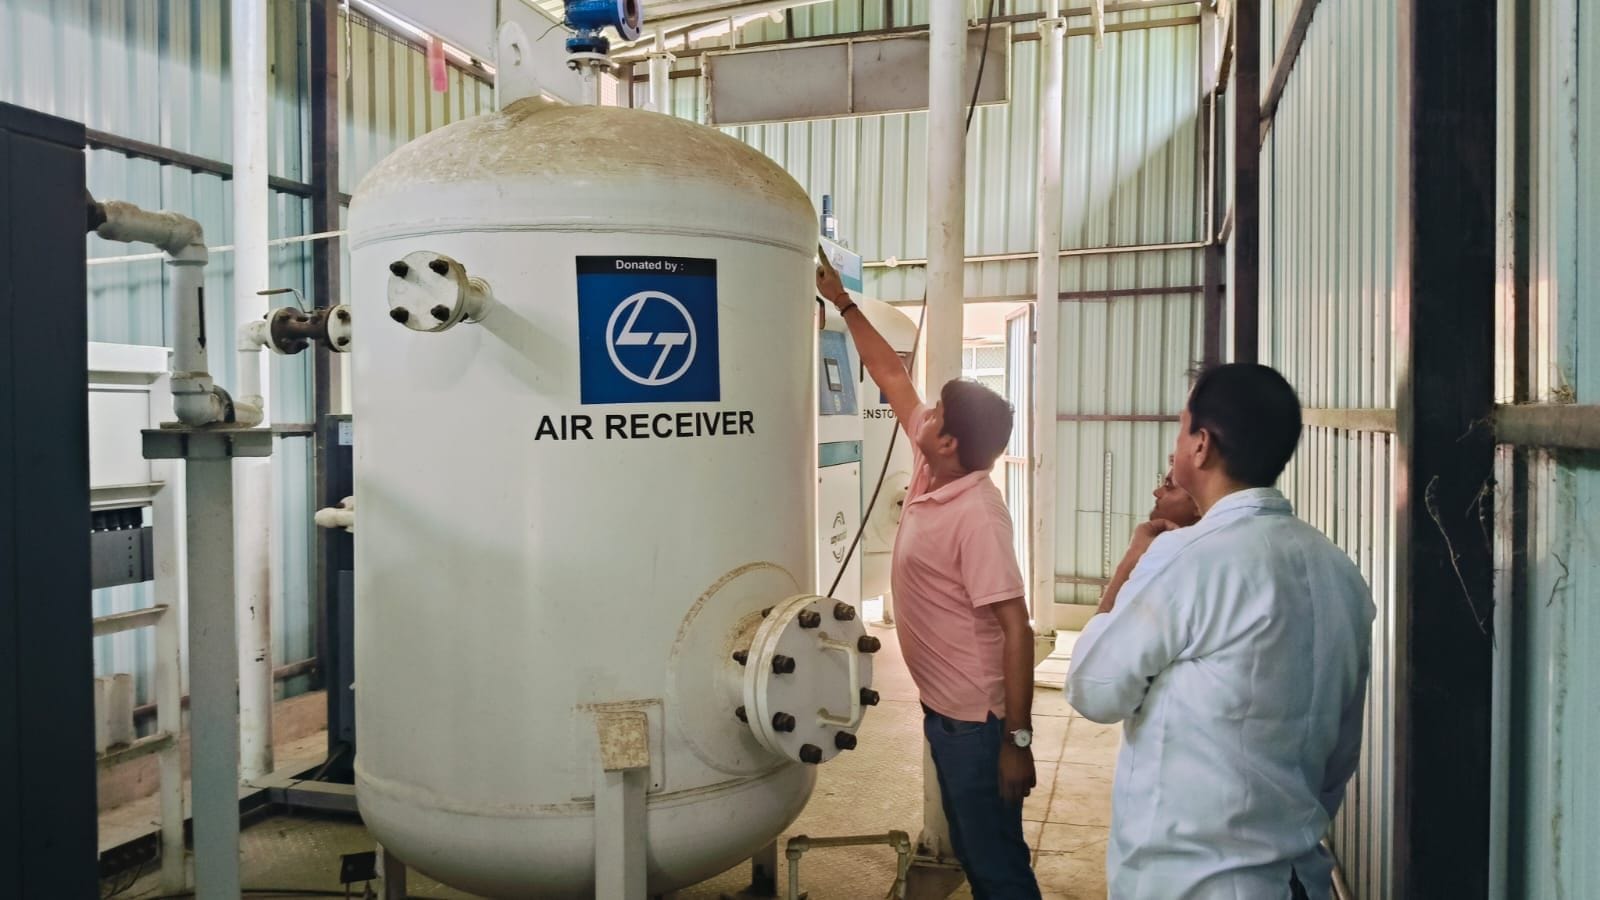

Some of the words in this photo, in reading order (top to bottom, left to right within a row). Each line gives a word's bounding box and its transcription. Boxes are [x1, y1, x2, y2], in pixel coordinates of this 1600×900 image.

[615, 260, 661, 270] Donated
[665, 260, 677, 272] by
[534, 415, 594, 441] AIR
[605, 410, 755, 439] RECEIVER
